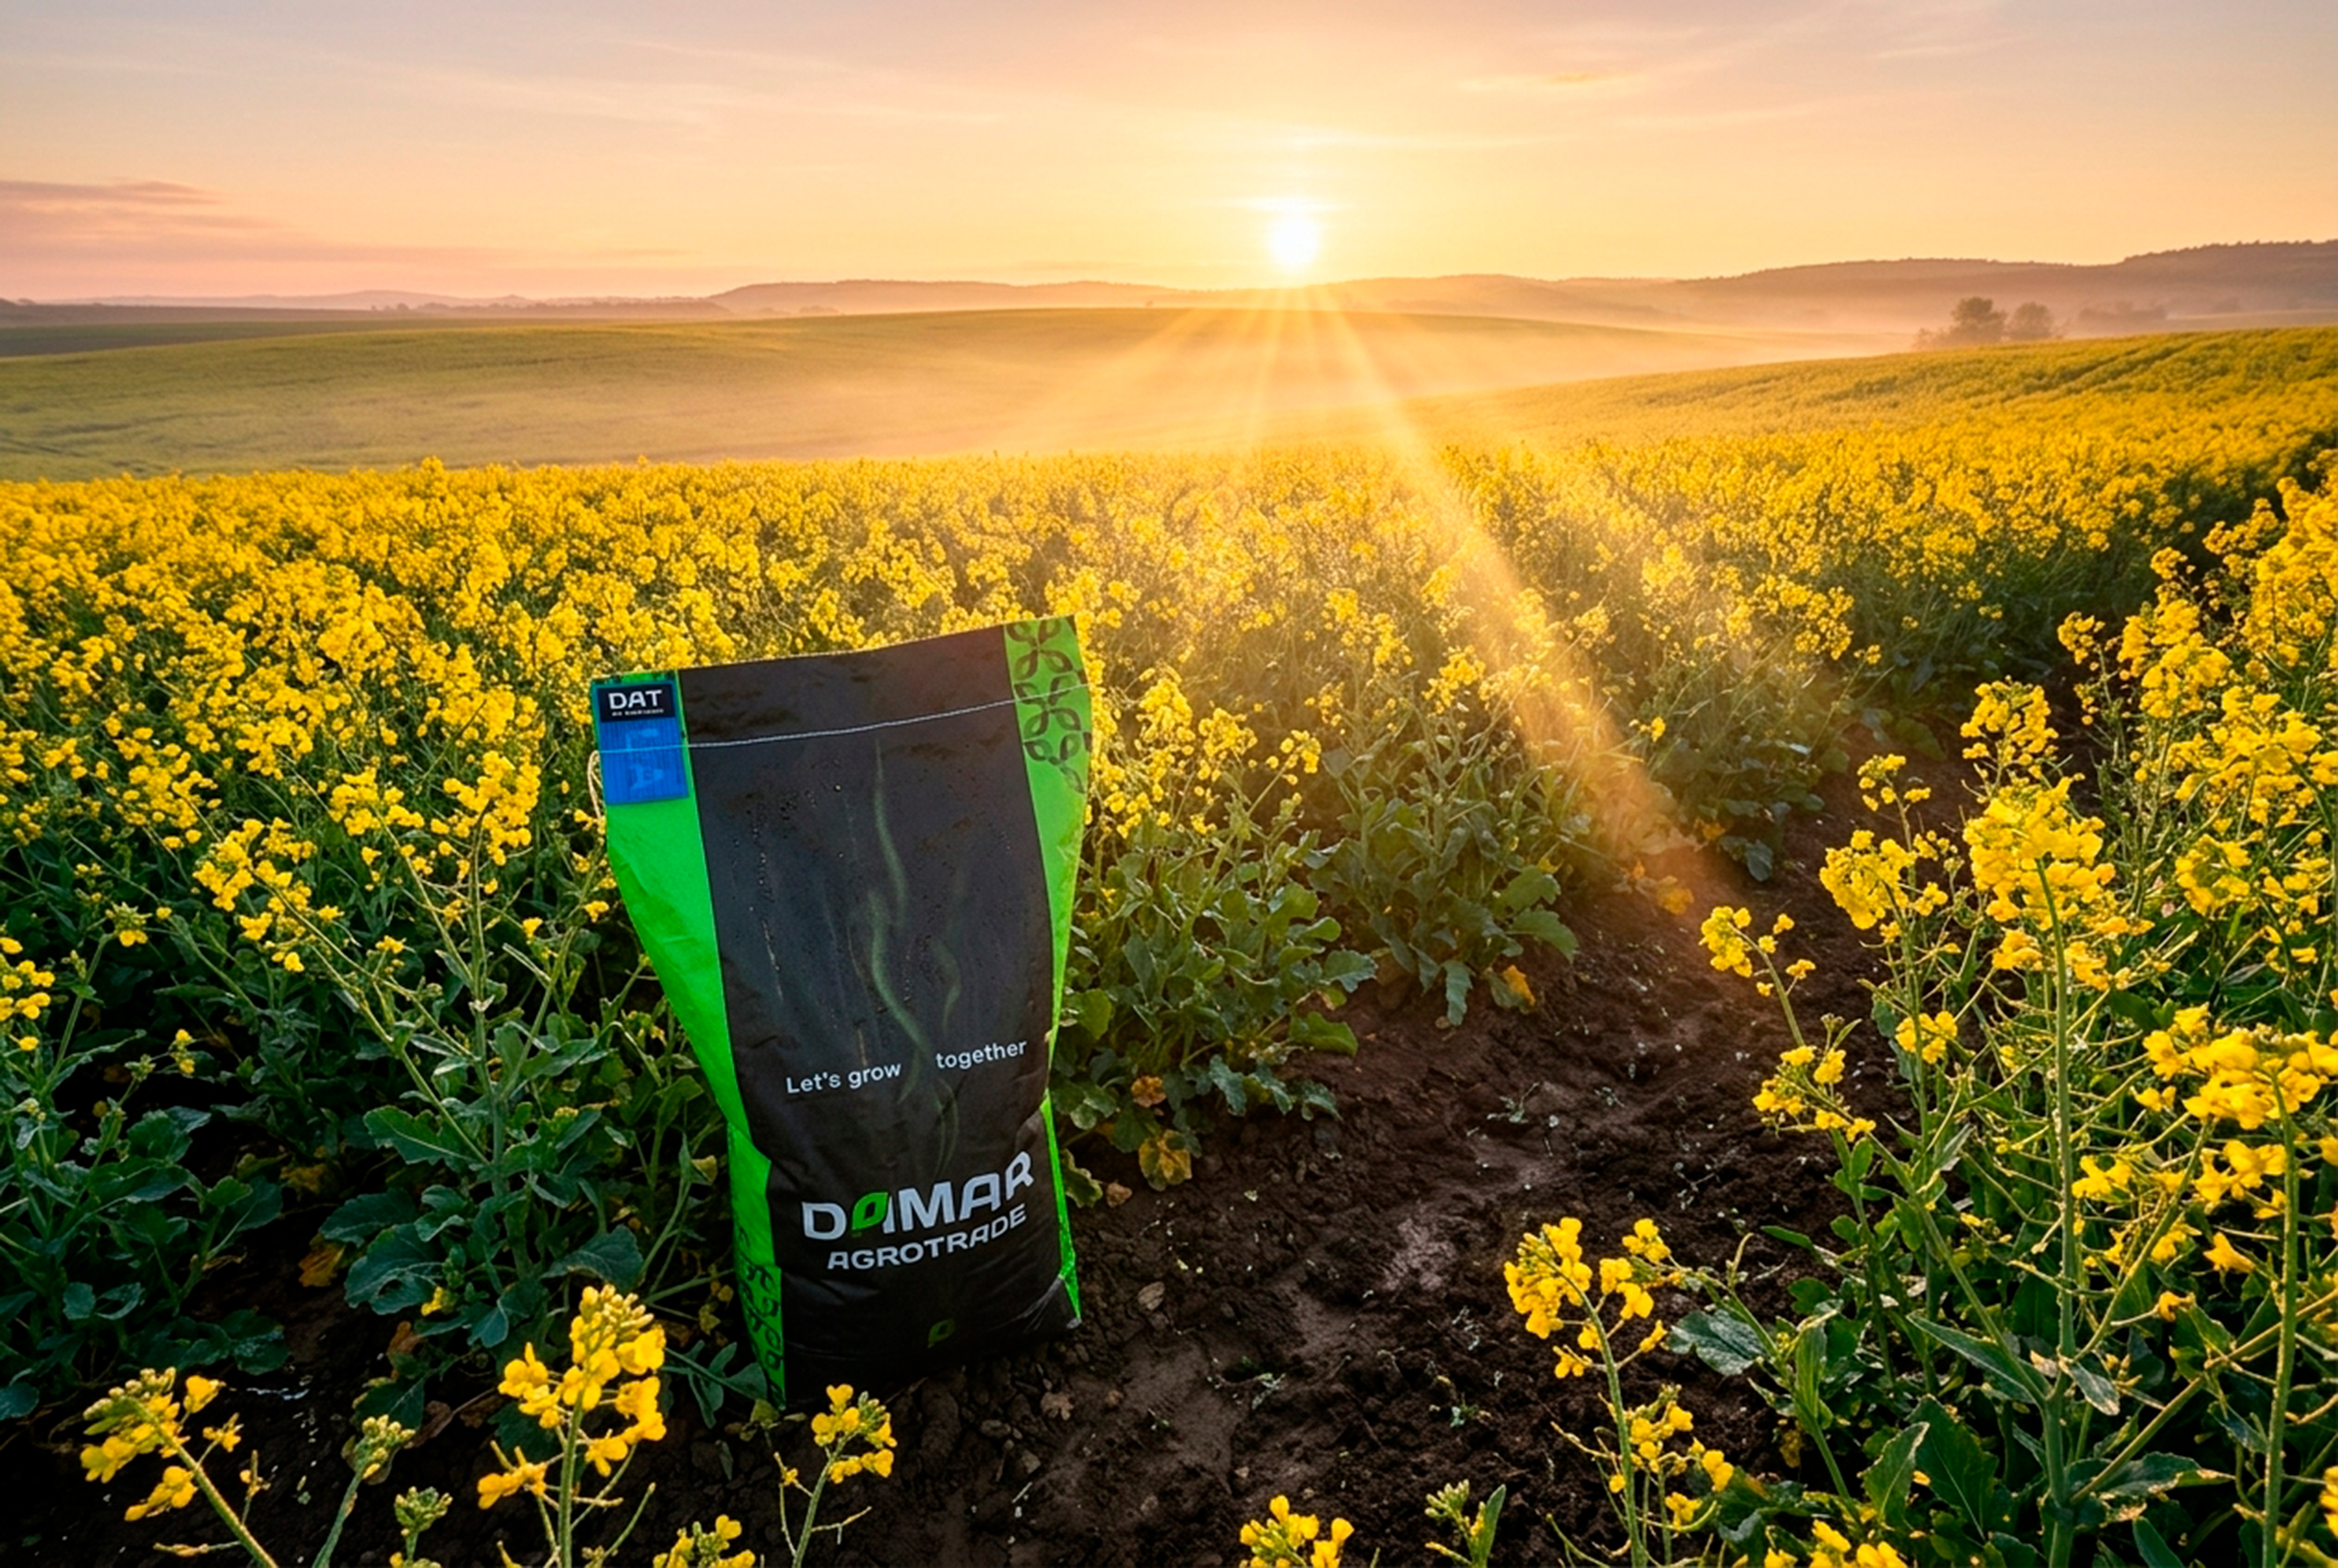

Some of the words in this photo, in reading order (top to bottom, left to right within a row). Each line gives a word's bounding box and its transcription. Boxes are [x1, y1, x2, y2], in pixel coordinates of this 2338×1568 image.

[608, 689, 662, 710] DAT
[786, 1072, 841, 1094] Let's
[848, 1063, 902, 1089] grow
[936, 1040, 1027, 1069] together
[827, 1203, 1027, 1269] AGROTRADE
